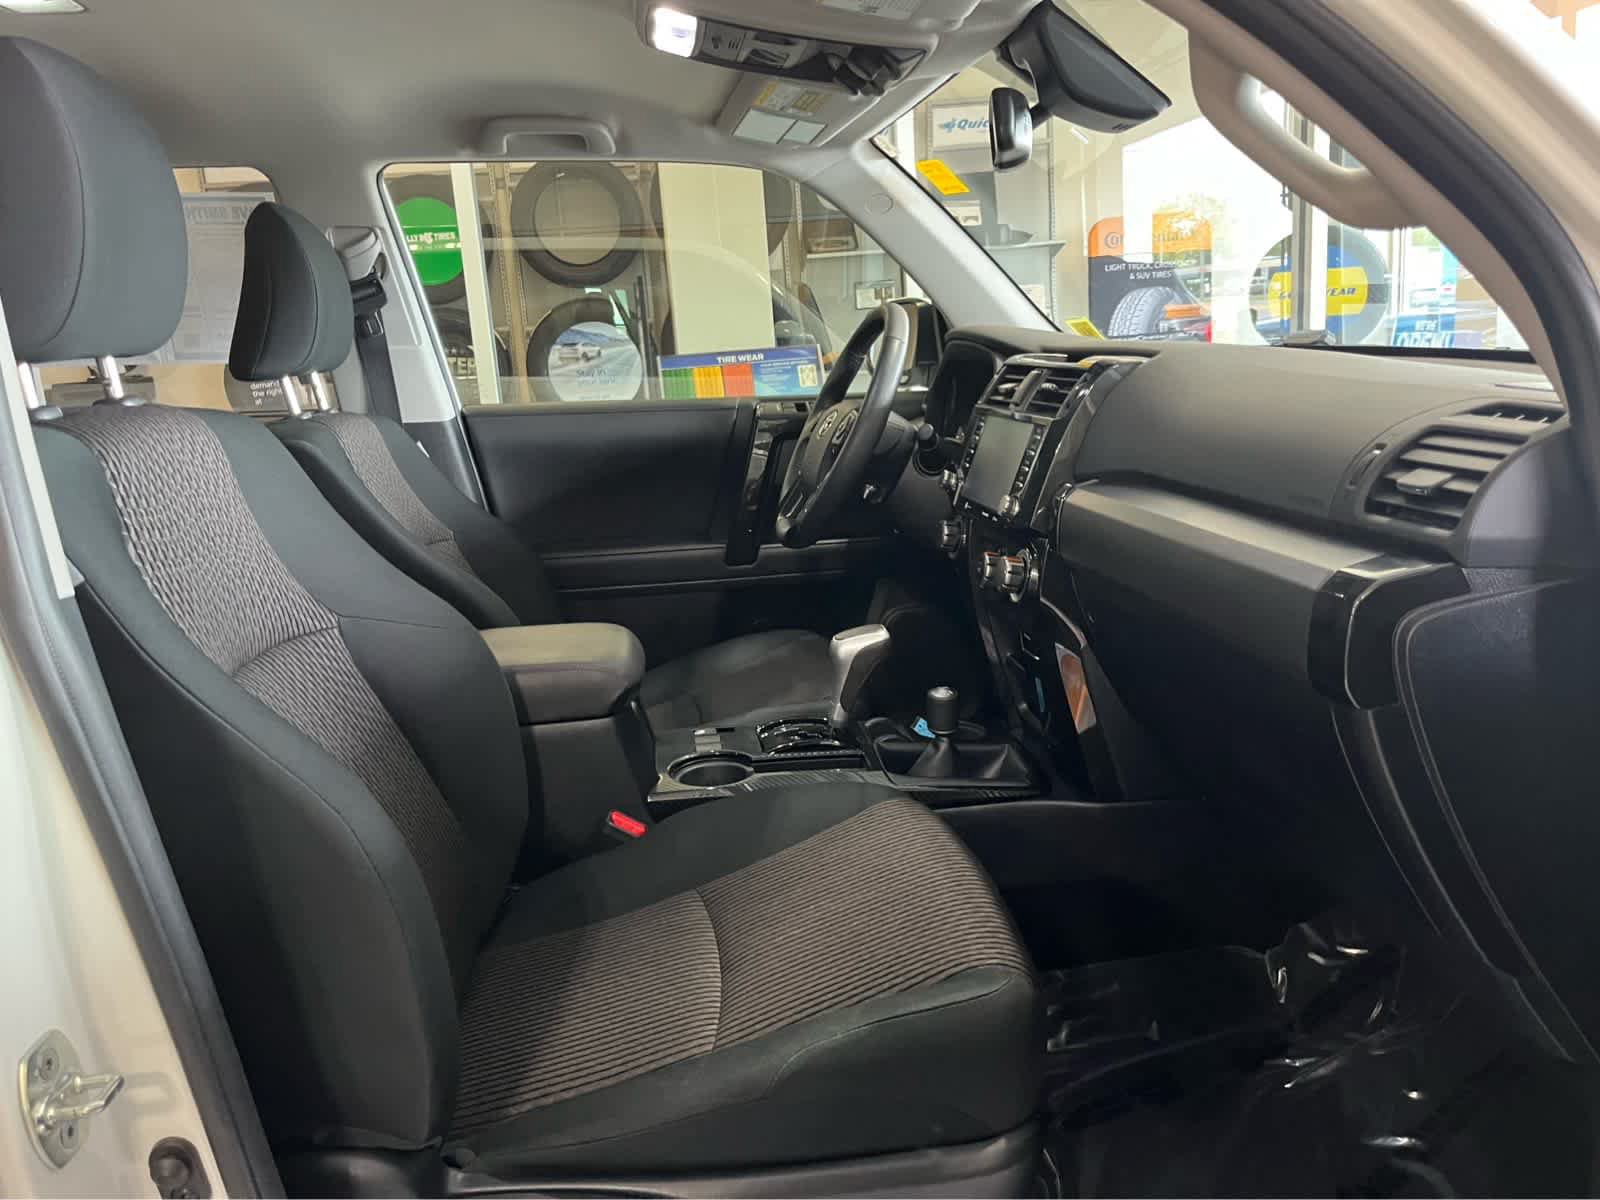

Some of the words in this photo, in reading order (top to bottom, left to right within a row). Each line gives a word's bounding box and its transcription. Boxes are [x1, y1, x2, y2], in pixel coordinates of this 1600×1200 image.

[957, 117, 990, 130] Quic
[1136, 272, 1151, 280] SUV
[716, 355, 737, 364] TIRE
[738, 352, 764, 363] WEAR
